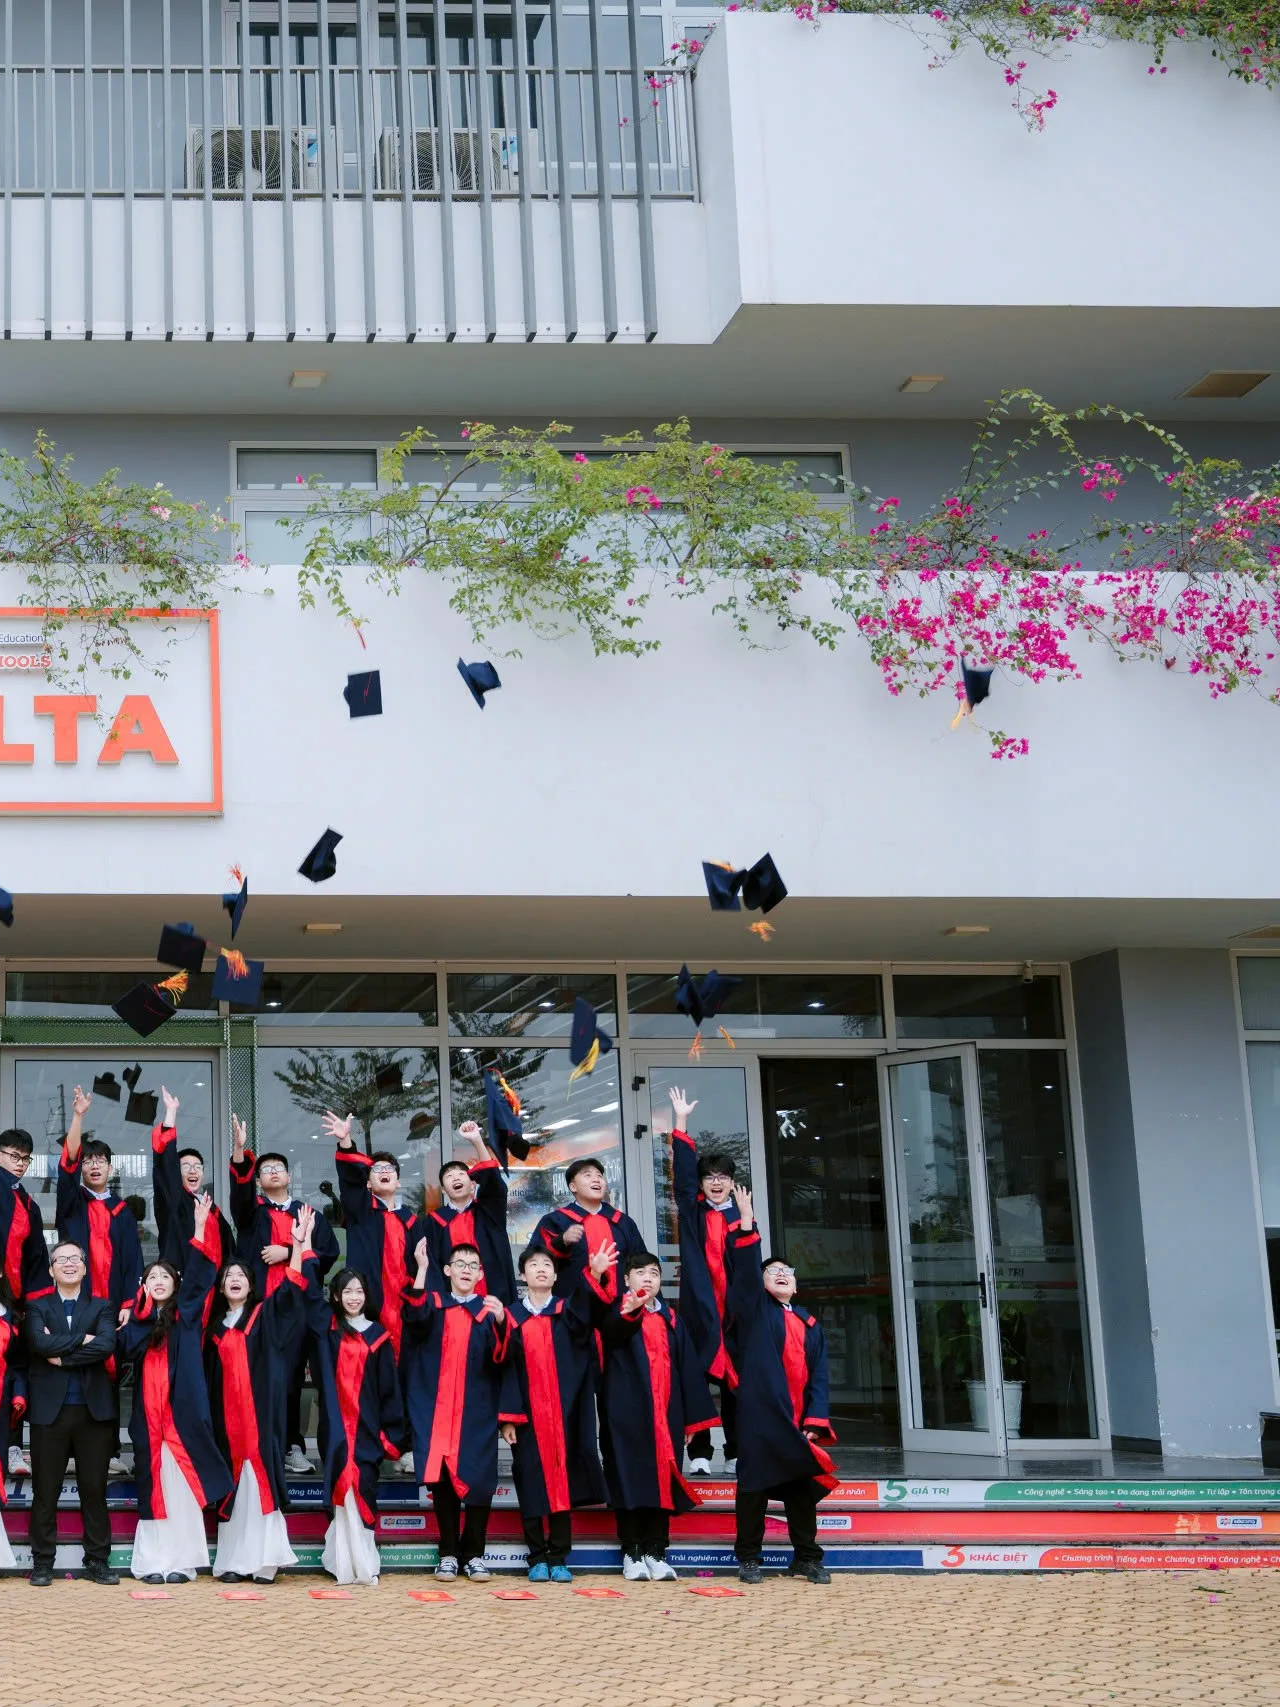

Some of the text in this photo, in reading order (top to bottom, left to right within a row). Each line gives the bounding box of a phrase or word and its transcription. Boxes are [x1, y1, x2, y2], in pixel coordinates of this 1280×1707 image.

[714, 1488, 734, 1497] nghệ
[846, 1487, 866, 1495] nhân
[883, 1480, 950, 1501] 5 GIÁ TRỊ
[1024, 1488, 1044, 1497] Công
[1045, 1488, 1065, 1497] nghệ
[1073, 1487, 1093, 1497] Sáng
[1095, 1488, 1108, 1497] tạo
[1129, 1487, 1150, 1498] dạng
[1166, 1487, 1196, 1498] nghiệm
[1217, 1487, 1230, 1498] lập
[1238, 1487, 1253, 1495] Tôn
[1254, 1488, 1276, 1498] trọng
[687, 1553, 718, 1562] nghiệm
[720, 1553, 732, 1561] để
[940, 1545, 1028, 1567] 3 KHÁC BIỆT
[1061, 1554, 1093, 1563] Chương
[1094, 1553, 1114, 1562] trình
[1115, 1553, 1137, 1564] Tiếng
[1139, 1555, 1155, 1563] Anh
[1164, 1555, 1196, 1565] Chương
[1197, 1555, 1217, 1563] trình
[1218, 1555, 1239, 1565] Công
[1240, 1555, 1261, 1566] nghệ
